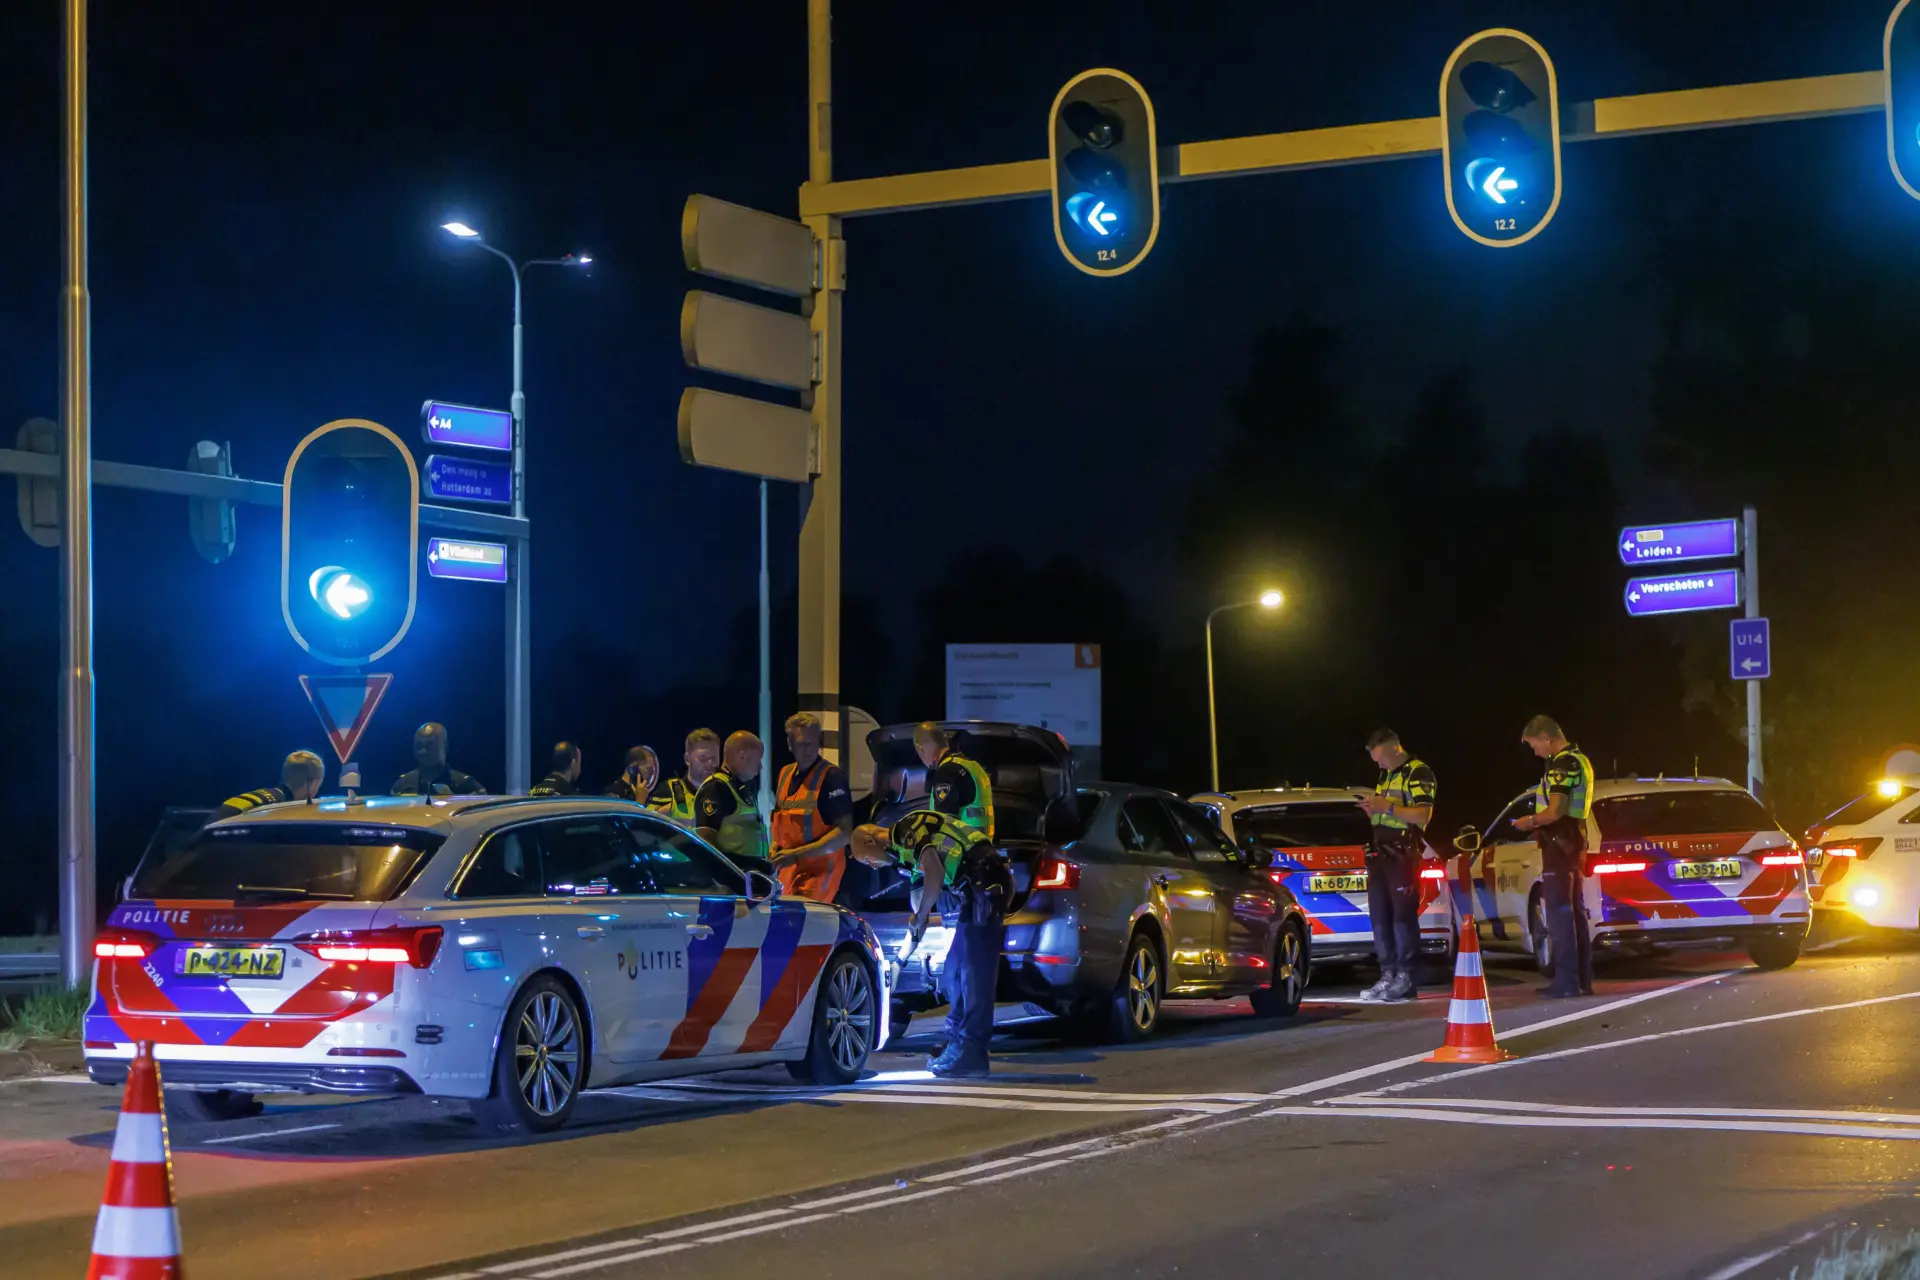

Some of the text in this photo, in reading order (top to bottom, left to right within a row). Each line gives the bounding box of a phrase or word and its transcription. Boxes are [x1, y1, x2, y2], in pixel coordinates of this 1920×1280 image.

[1494, 218, 1516, 231] 12.2
[1097, 249, 1117, 261] 12.4
[439, 417, 452, 430] A4
[441, 480, 482, 495] Rotterdam
[1636, 545, 1682, 558] Leiden 2
[1640, 578, 1714, 594] Voorschoten 4
[1737, 633, 1763, 646] U14
[1625, 840, 1679, 852] POLITIE
[1274, 853, 1314, 862] LITIE
[1314, 876, 1368, 889] R-687-R
[122, 910, 191, 924] POLITIE
[189, 951, 278, 973] P-424-NZ
[143, 962, 164, 987] 2240
